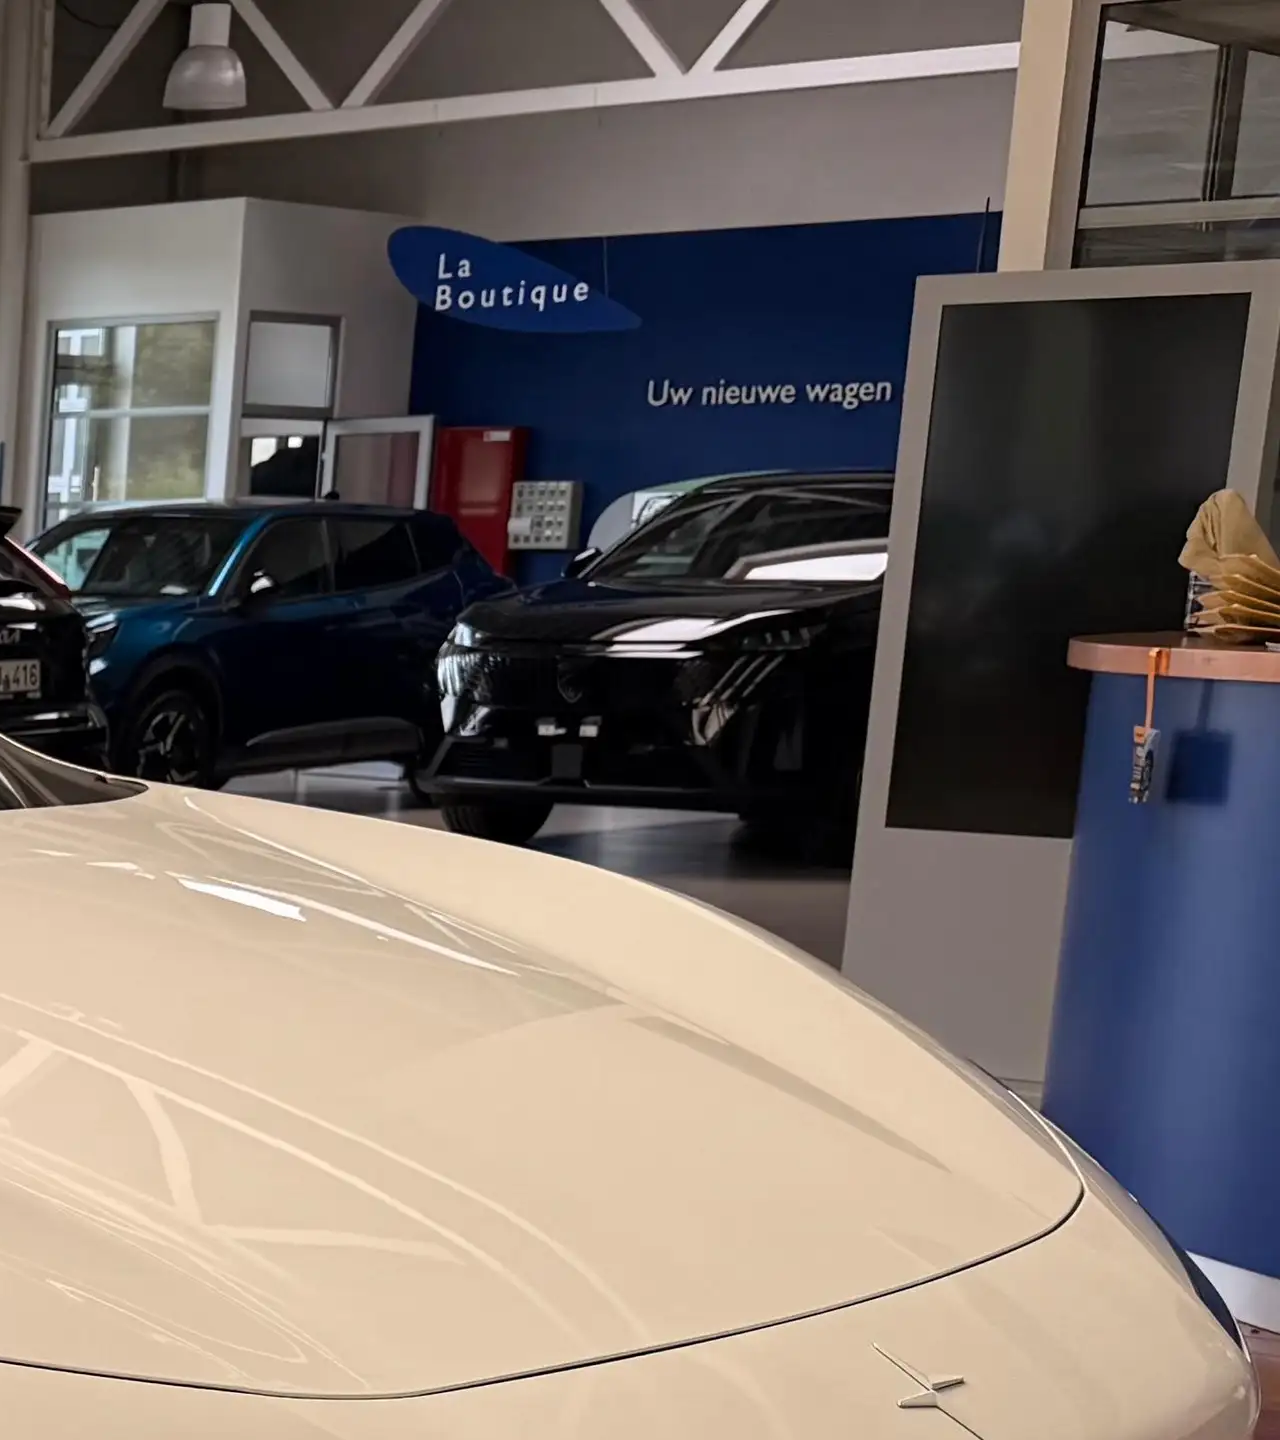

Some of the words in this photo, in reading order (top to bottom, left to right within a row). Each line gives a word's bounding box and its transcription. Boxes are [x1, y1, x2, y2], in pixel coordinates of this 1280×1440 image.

[438, 253, 472, 280] La
[435, 279, 589, 312] Boutique
[647, 379, 693, 407] Uw
[701, 378, 797, 406] nieuwe
[805, 380, 892, 410] wagen
